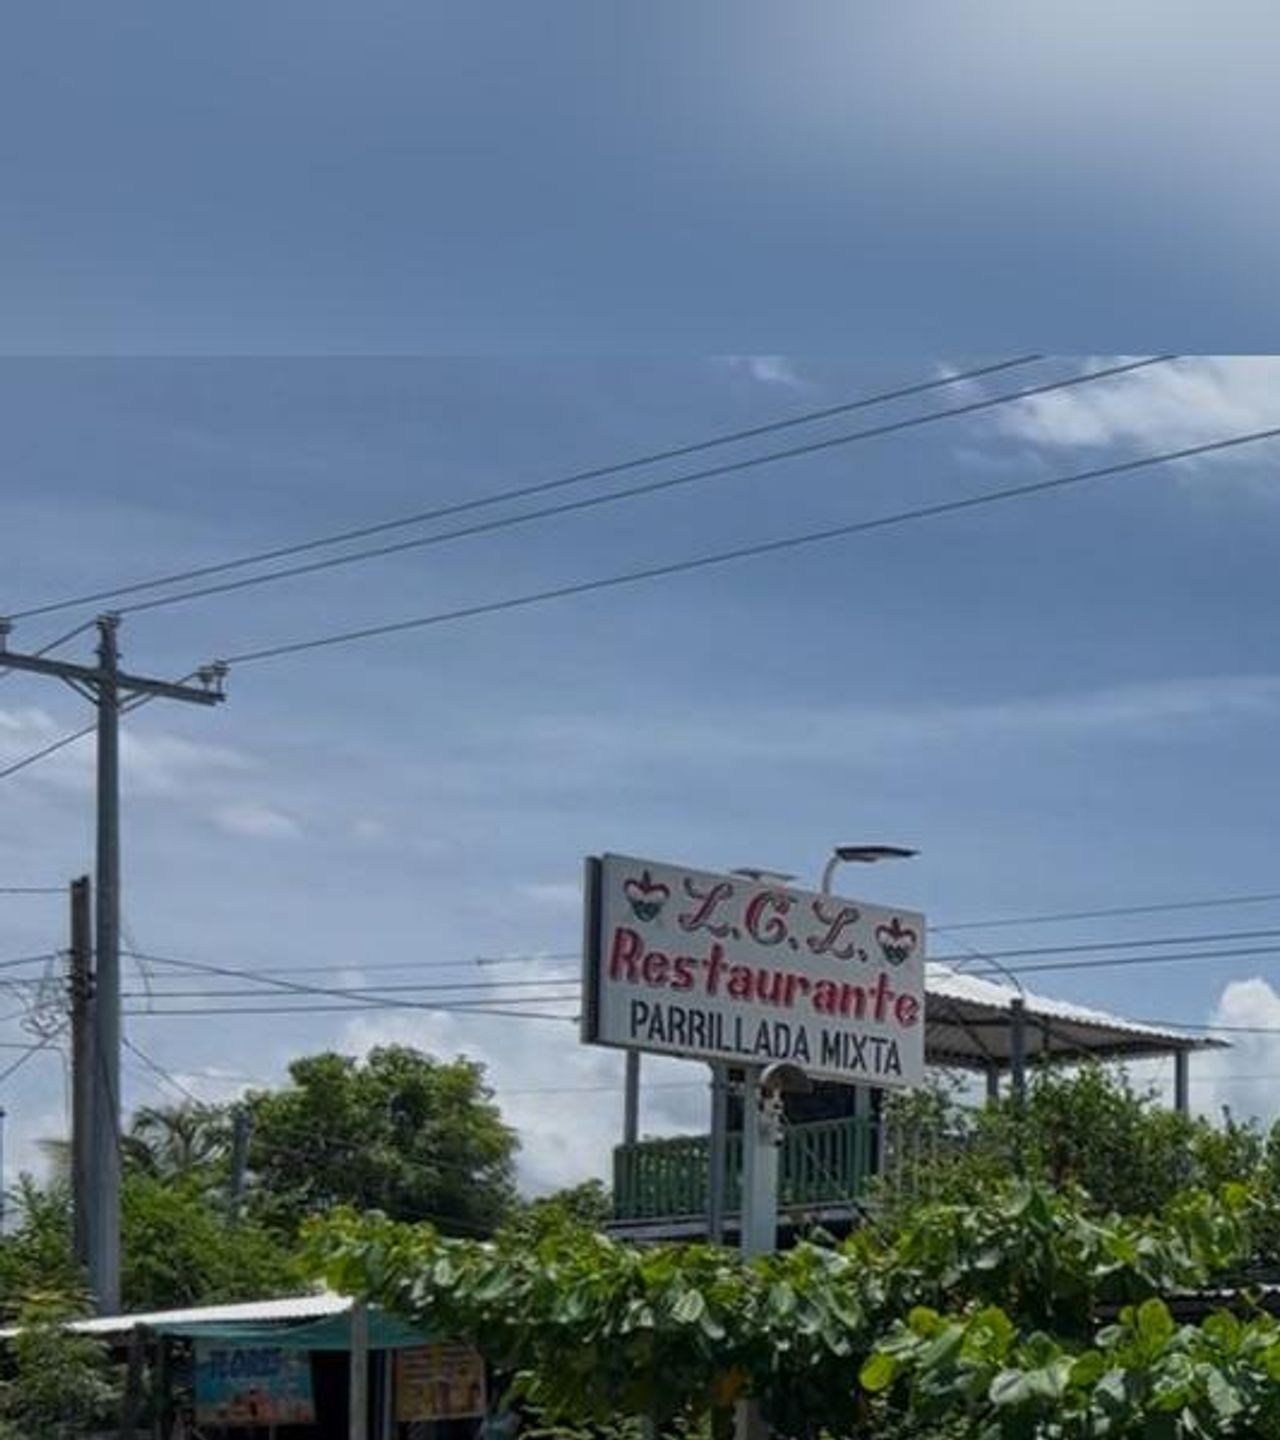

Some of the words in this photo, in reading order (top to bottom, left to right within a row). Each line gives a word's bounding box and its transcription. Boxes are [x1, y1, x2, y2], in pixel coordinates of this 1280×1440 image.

[609, 926, 918, 1028] Restaurante
[631, 1000, 811, 1064] PARRILLADA
[821, 1030, 901, 1075] MIXTA
